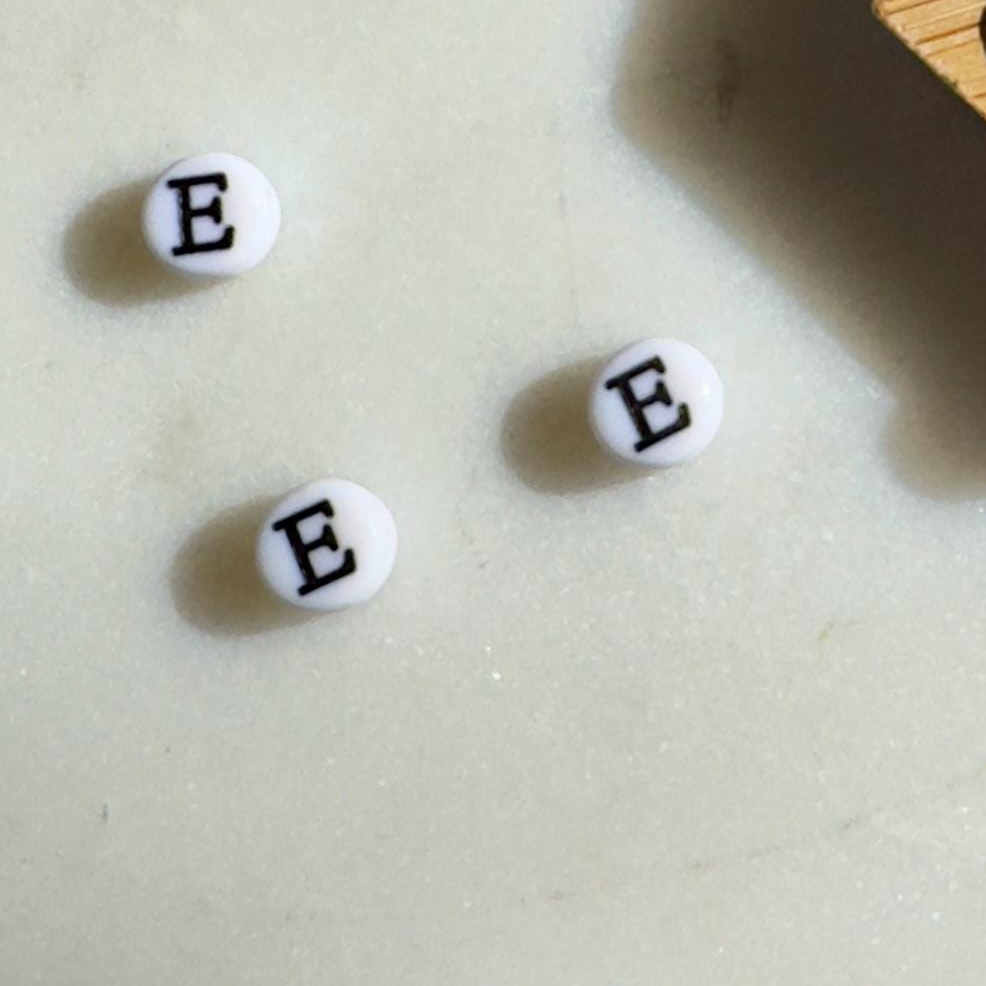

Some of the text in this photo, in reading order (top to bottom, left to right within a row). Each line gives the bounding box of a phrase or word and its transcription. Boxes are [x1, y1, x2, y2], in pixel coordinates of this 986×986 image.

[166, 172, 235, 258] E
[604, 356, 694, 453] E
[271, 499, 358, 597] E
